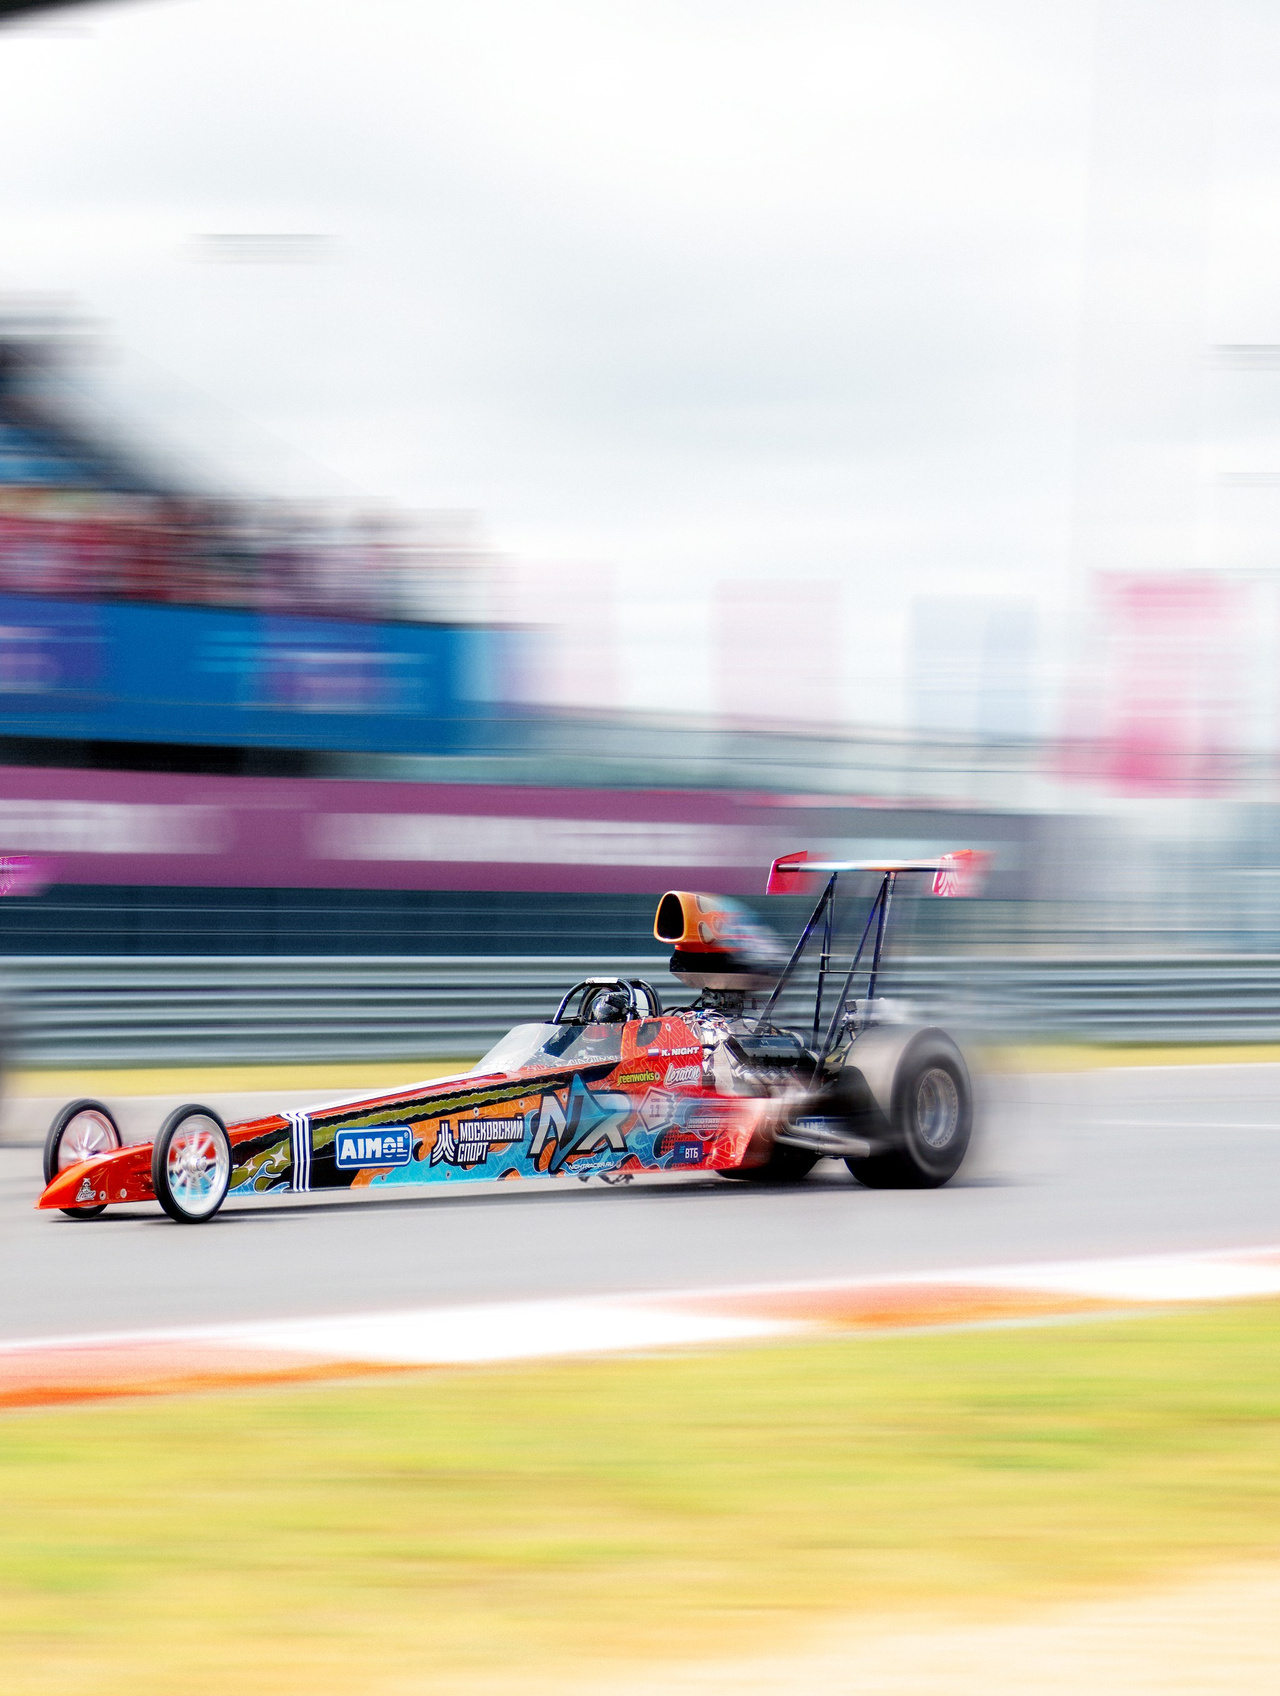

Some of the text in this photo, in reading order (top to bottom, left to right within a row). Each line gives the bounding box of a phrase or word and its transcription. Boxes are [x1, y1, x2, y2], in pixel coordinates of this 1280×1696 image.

[661, 1046, 699, 1057] K. NIGHT
[459, 1116, 523, 1141] МОСКОВСКИЙ
[340, 1136, 408, 1160] AIMOL
[457, 1142, 489, 1162] СПОРТ
[685, 1147, 699, 1159] ВТБ
